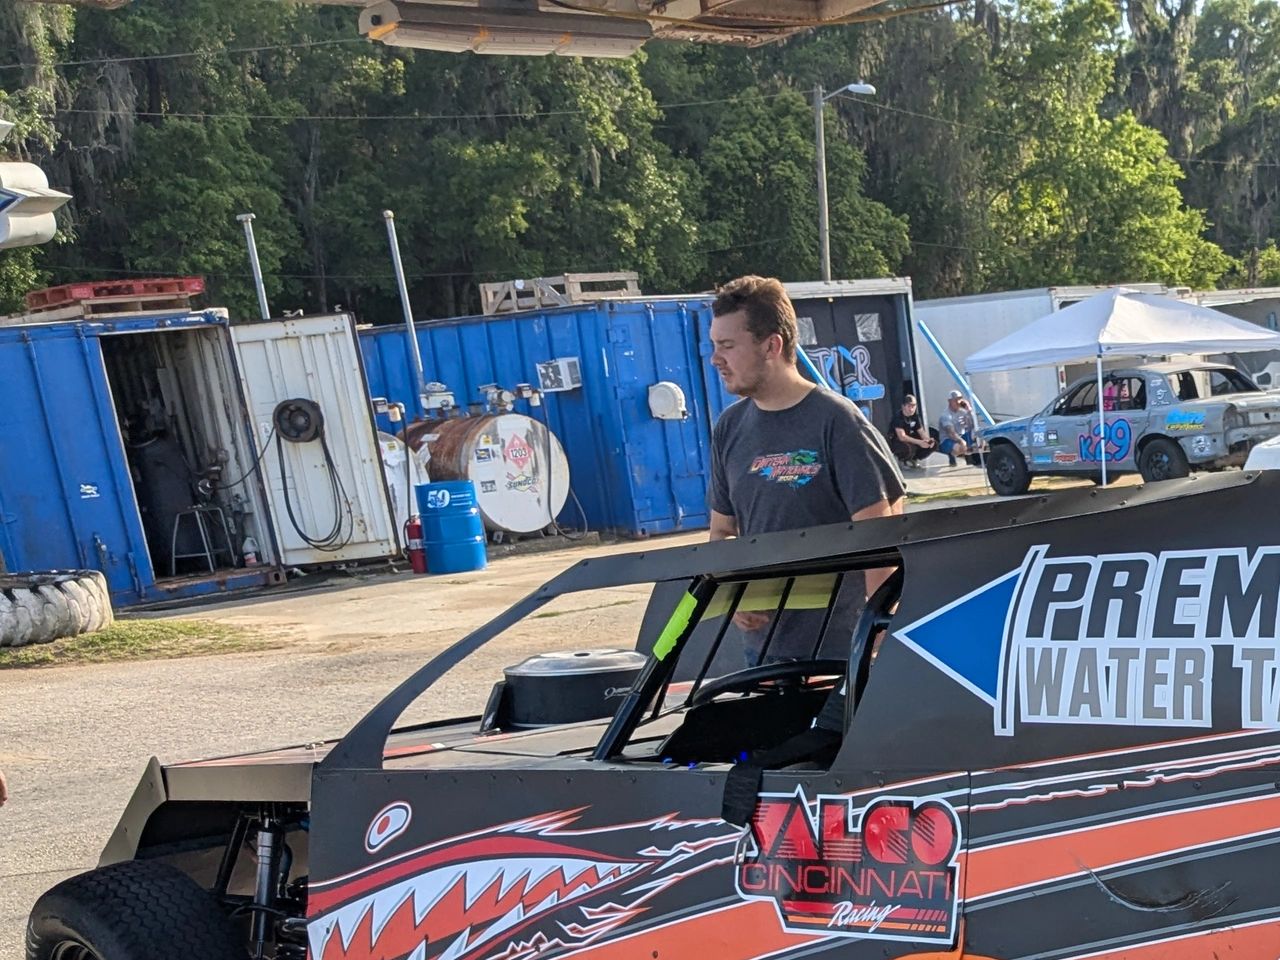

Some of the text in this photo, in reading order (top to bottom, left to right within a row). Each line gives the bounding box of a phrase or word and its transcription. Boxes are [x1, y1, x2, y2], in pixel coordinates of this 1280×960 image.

[510, 447, 528, 458] 1203
[1078, 418, 1133, 463] K29
[505, 476, 537, 489] SUNOCO
[1024, 646, 1205, 721] WATER
[741, 863, 951, 900] CINCINNATI
[827, 900, 901, 933] Racing
